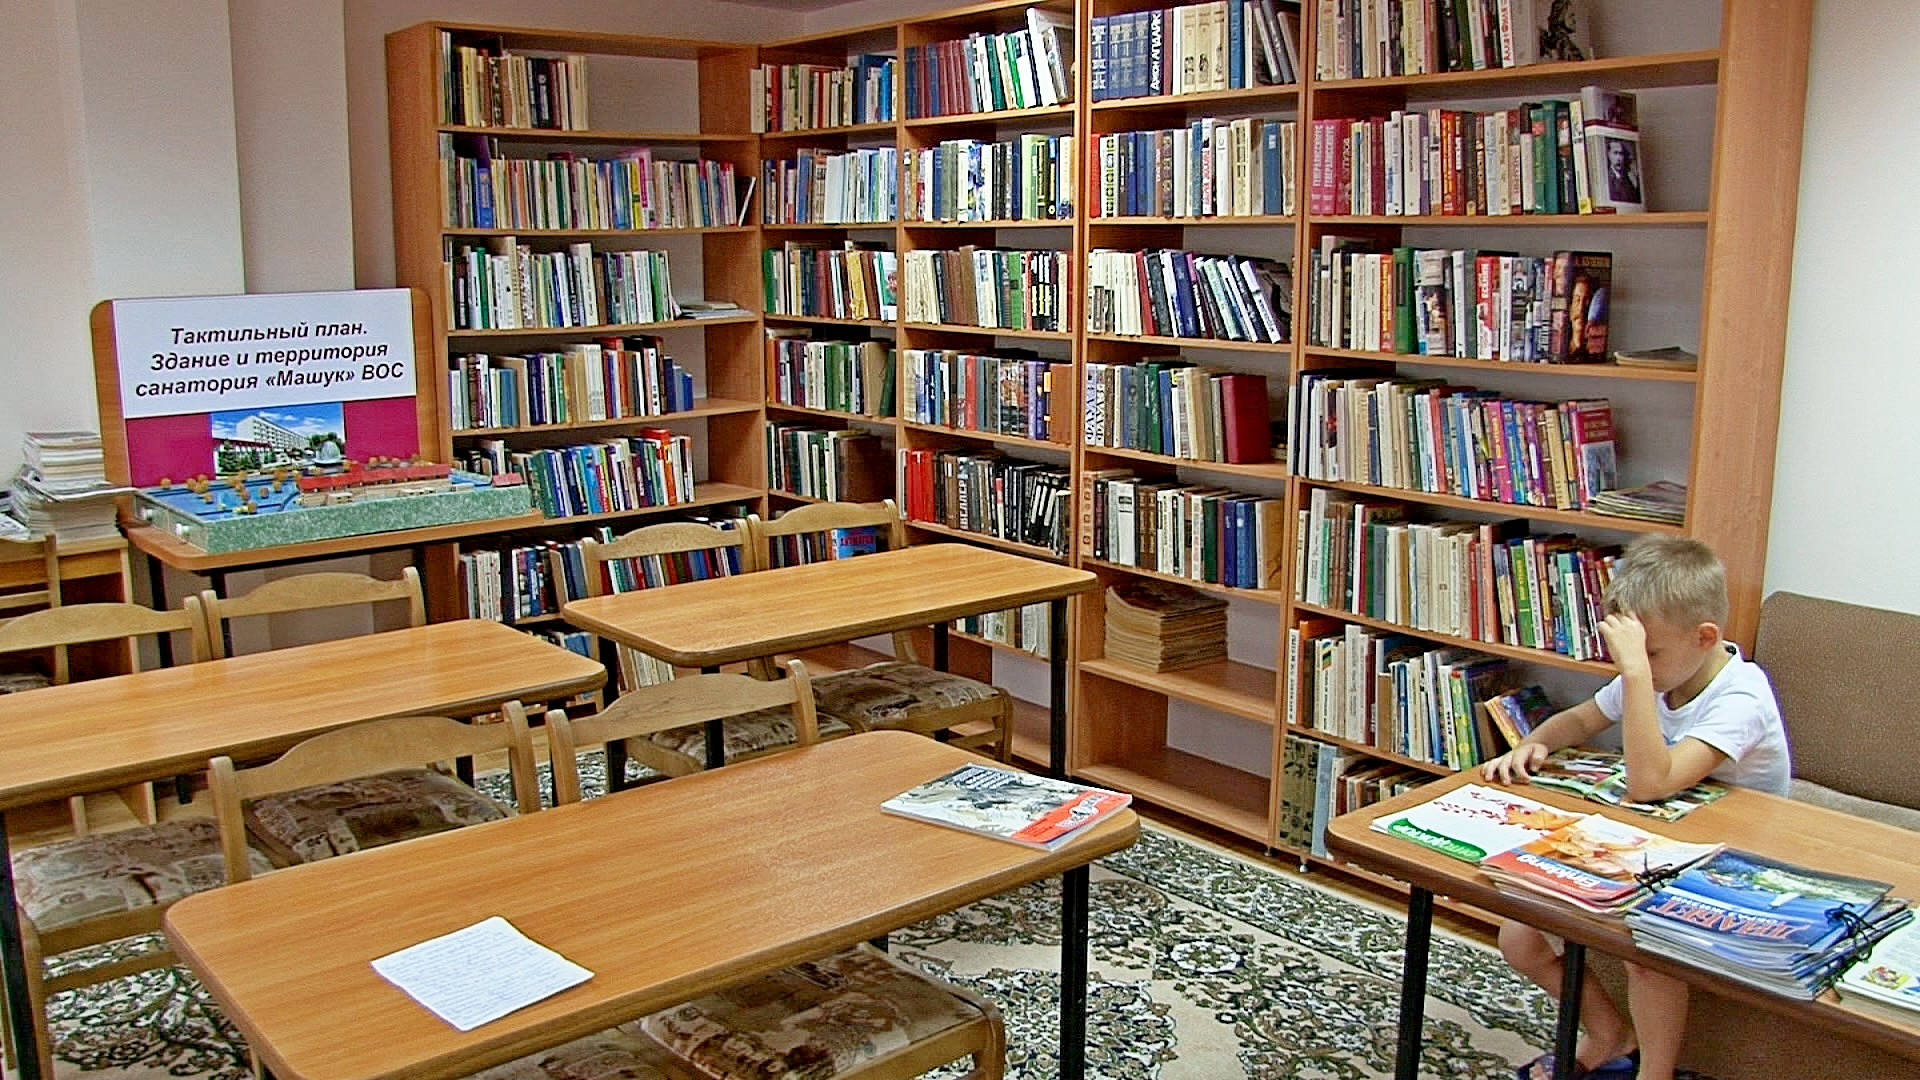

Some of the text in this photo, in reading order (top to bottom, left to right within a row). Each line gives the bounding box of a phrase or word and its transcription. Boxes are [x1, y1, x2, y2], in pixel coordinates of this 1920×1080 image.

[1150, 13, 1163, 60] АПДАЙК
[171, 320, 369, 346] Тактильный план.
[150, 343, 389, 372] Здание и территория
[135, 362, 405, 398] санатория «Машук» ВОС
[1647, 899, 1811, 941] ДИАБЕТ
